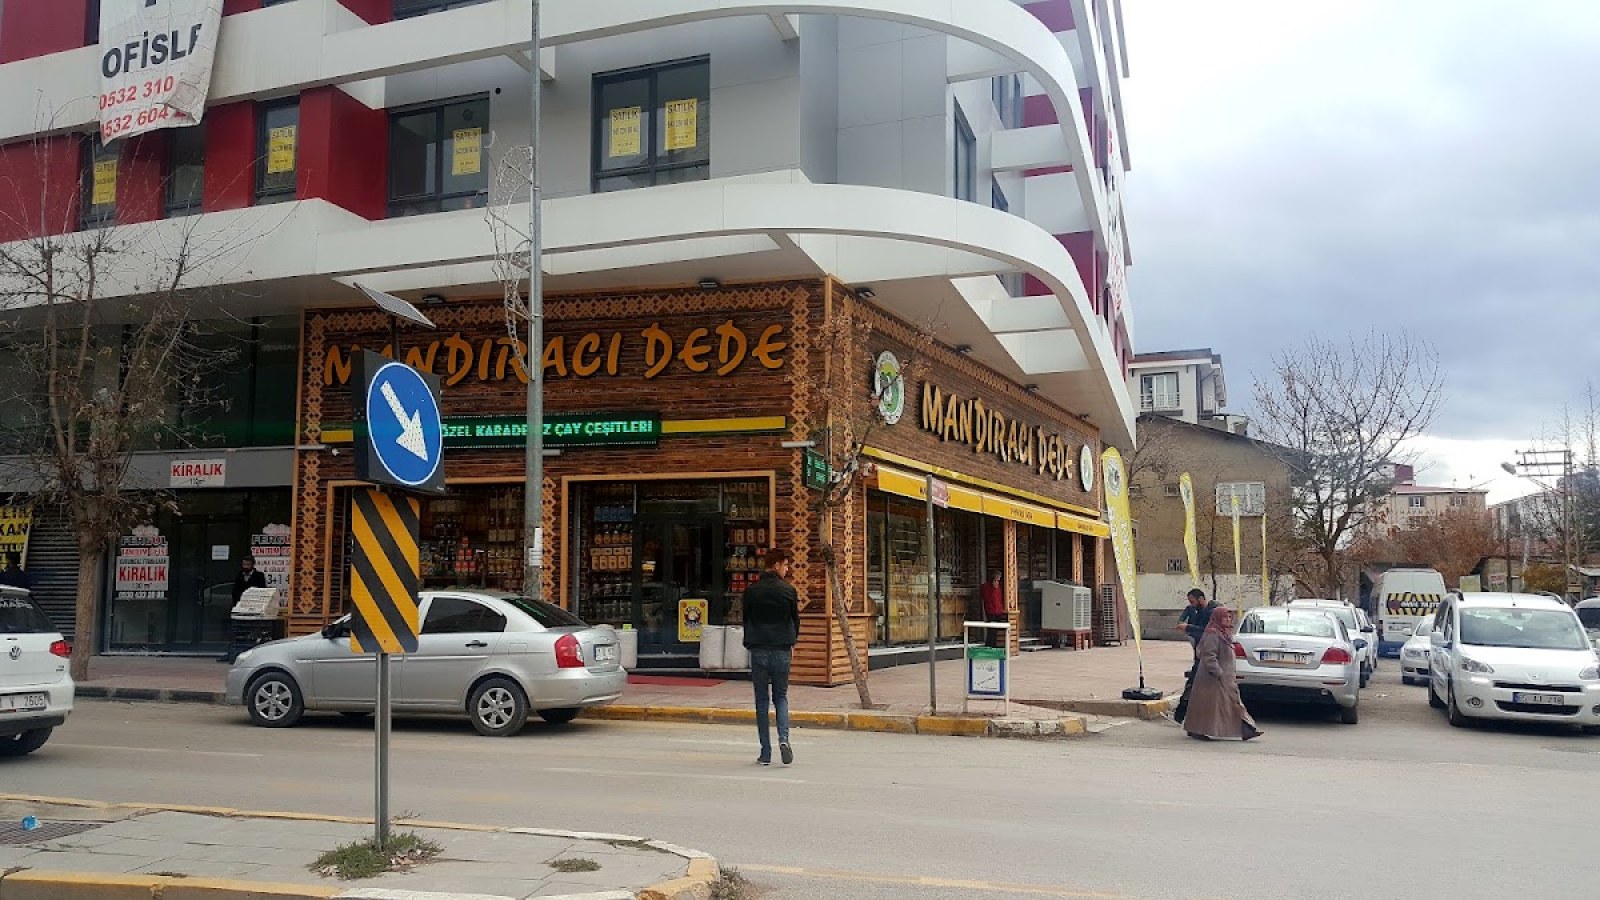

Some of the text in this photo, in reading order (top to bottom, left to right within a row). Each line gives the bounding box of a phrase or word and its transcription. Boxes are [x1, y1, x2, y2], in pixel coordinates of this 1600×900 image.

[99, 75, 175, 110] 0532 310
[137, 103, 170, 126] 604
[323, 319, 788, 387] MNDIRACI DEDE
[554, 422, 581, 437] ÇAY
[584, 419, 653, 437] ÇEŞİTLERİ
[922, 380, 1074, 482] MANDIRACI DEDE
[172, 462, 223, 477] KİRALIK
[118, 566, 166, 582] KİRALIK
[267, 574, 283, 585] 3+1
